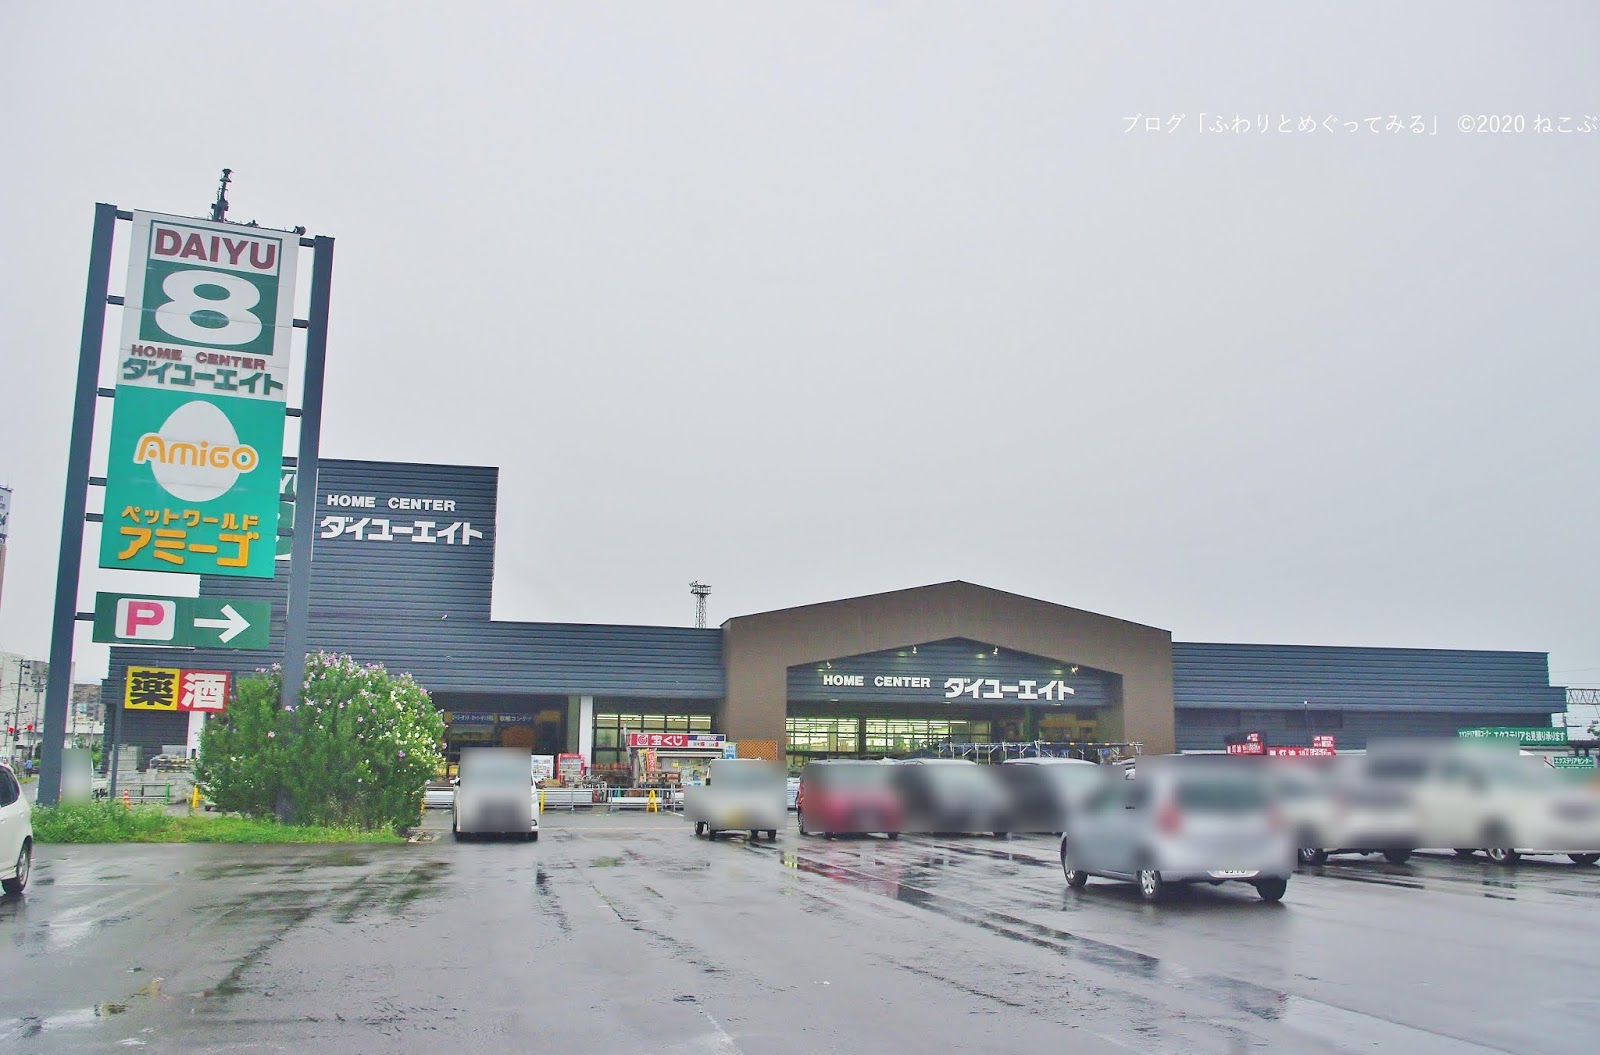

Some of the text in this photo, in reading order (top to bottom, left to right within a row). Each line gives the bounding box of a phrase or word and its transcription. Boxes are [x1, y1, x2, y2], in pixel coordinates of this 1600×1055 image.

[154, 228, 276, 270] DAIYU
[154, 269, 263, 345] 8
[131, 344, 267, 370] HOME CENTER
[122, 357, 284, 396] ダイユーエイト
[121, 505, 259, 531] ペットワールド
[327, 494, 456, 512] HOME CENTER
[117, 526, 260, 568] アミーゴ
[320, 515, 483, 546] ダイユーエイト
[125, 600, 165, 637] P
[130, 671, 228, 709] 薬 酒
[823, 674, 1075, 701] HOME CENTER ダイユーエイト
[650, 735, 689, 746] 宝くじ
